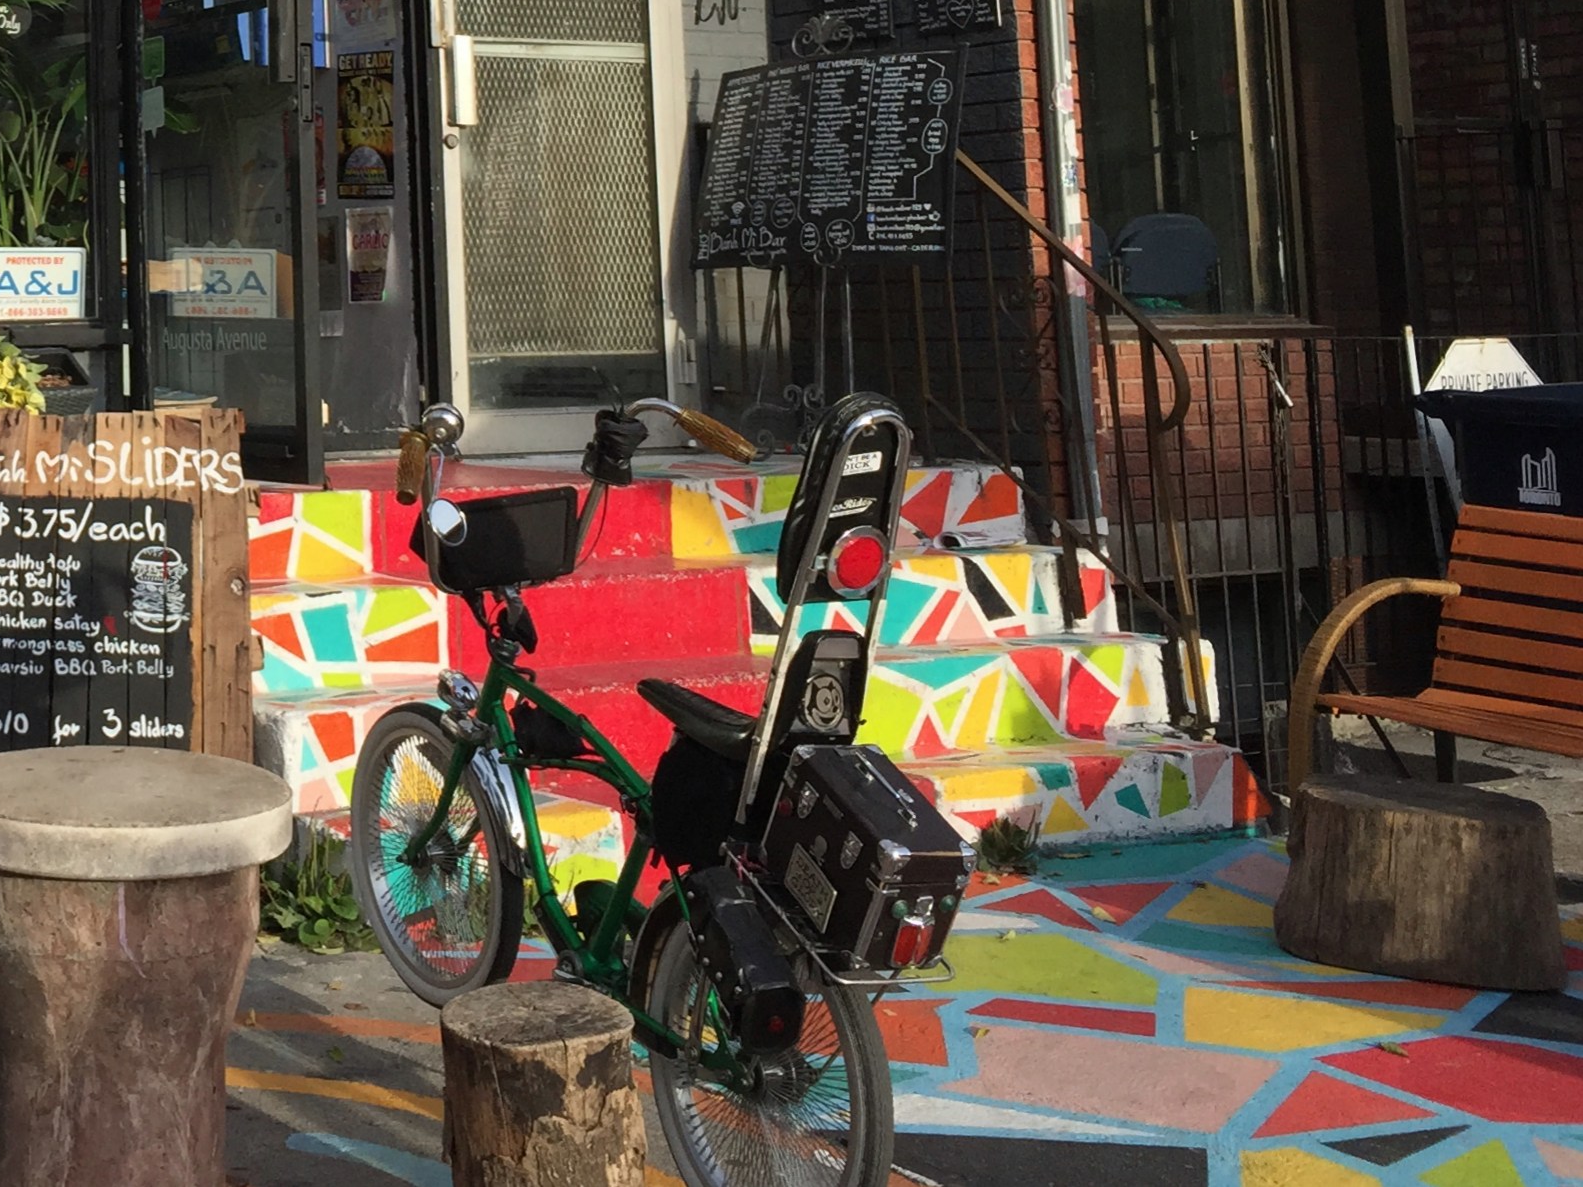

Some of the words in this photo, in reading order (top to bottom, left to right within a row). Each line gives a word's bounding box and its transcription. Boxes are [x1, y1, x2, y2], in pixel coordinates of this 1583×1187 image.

[339, 54, 357, 71] GET
[358, 52, 393, 70] READY
[6, 257, 52, 265] PROTECTED
[53, 257, 65, 265] BY
[162, 326, 213, 356] Augusta
[215, 326, 268, 351] Avenue
[1441, 373, 1483, 391] PRIVATE
[1485, 370, 1529, 389] PARKING
[1518, 488, 1561, 506] TORONTO
[25, 572, 71, 594] Belly
[32, 590, 76, 609] Duck
[94, 637, 160, 656] chicken
[54, 658, 97, 676] BBQ
[101, 658, 133, 675] Pork
[137, 659, 174, 679] Belly
[52, 715, 81, 745] for
[102, 708, 122, 739] 3
[129, 713, 184, 739] sliders
